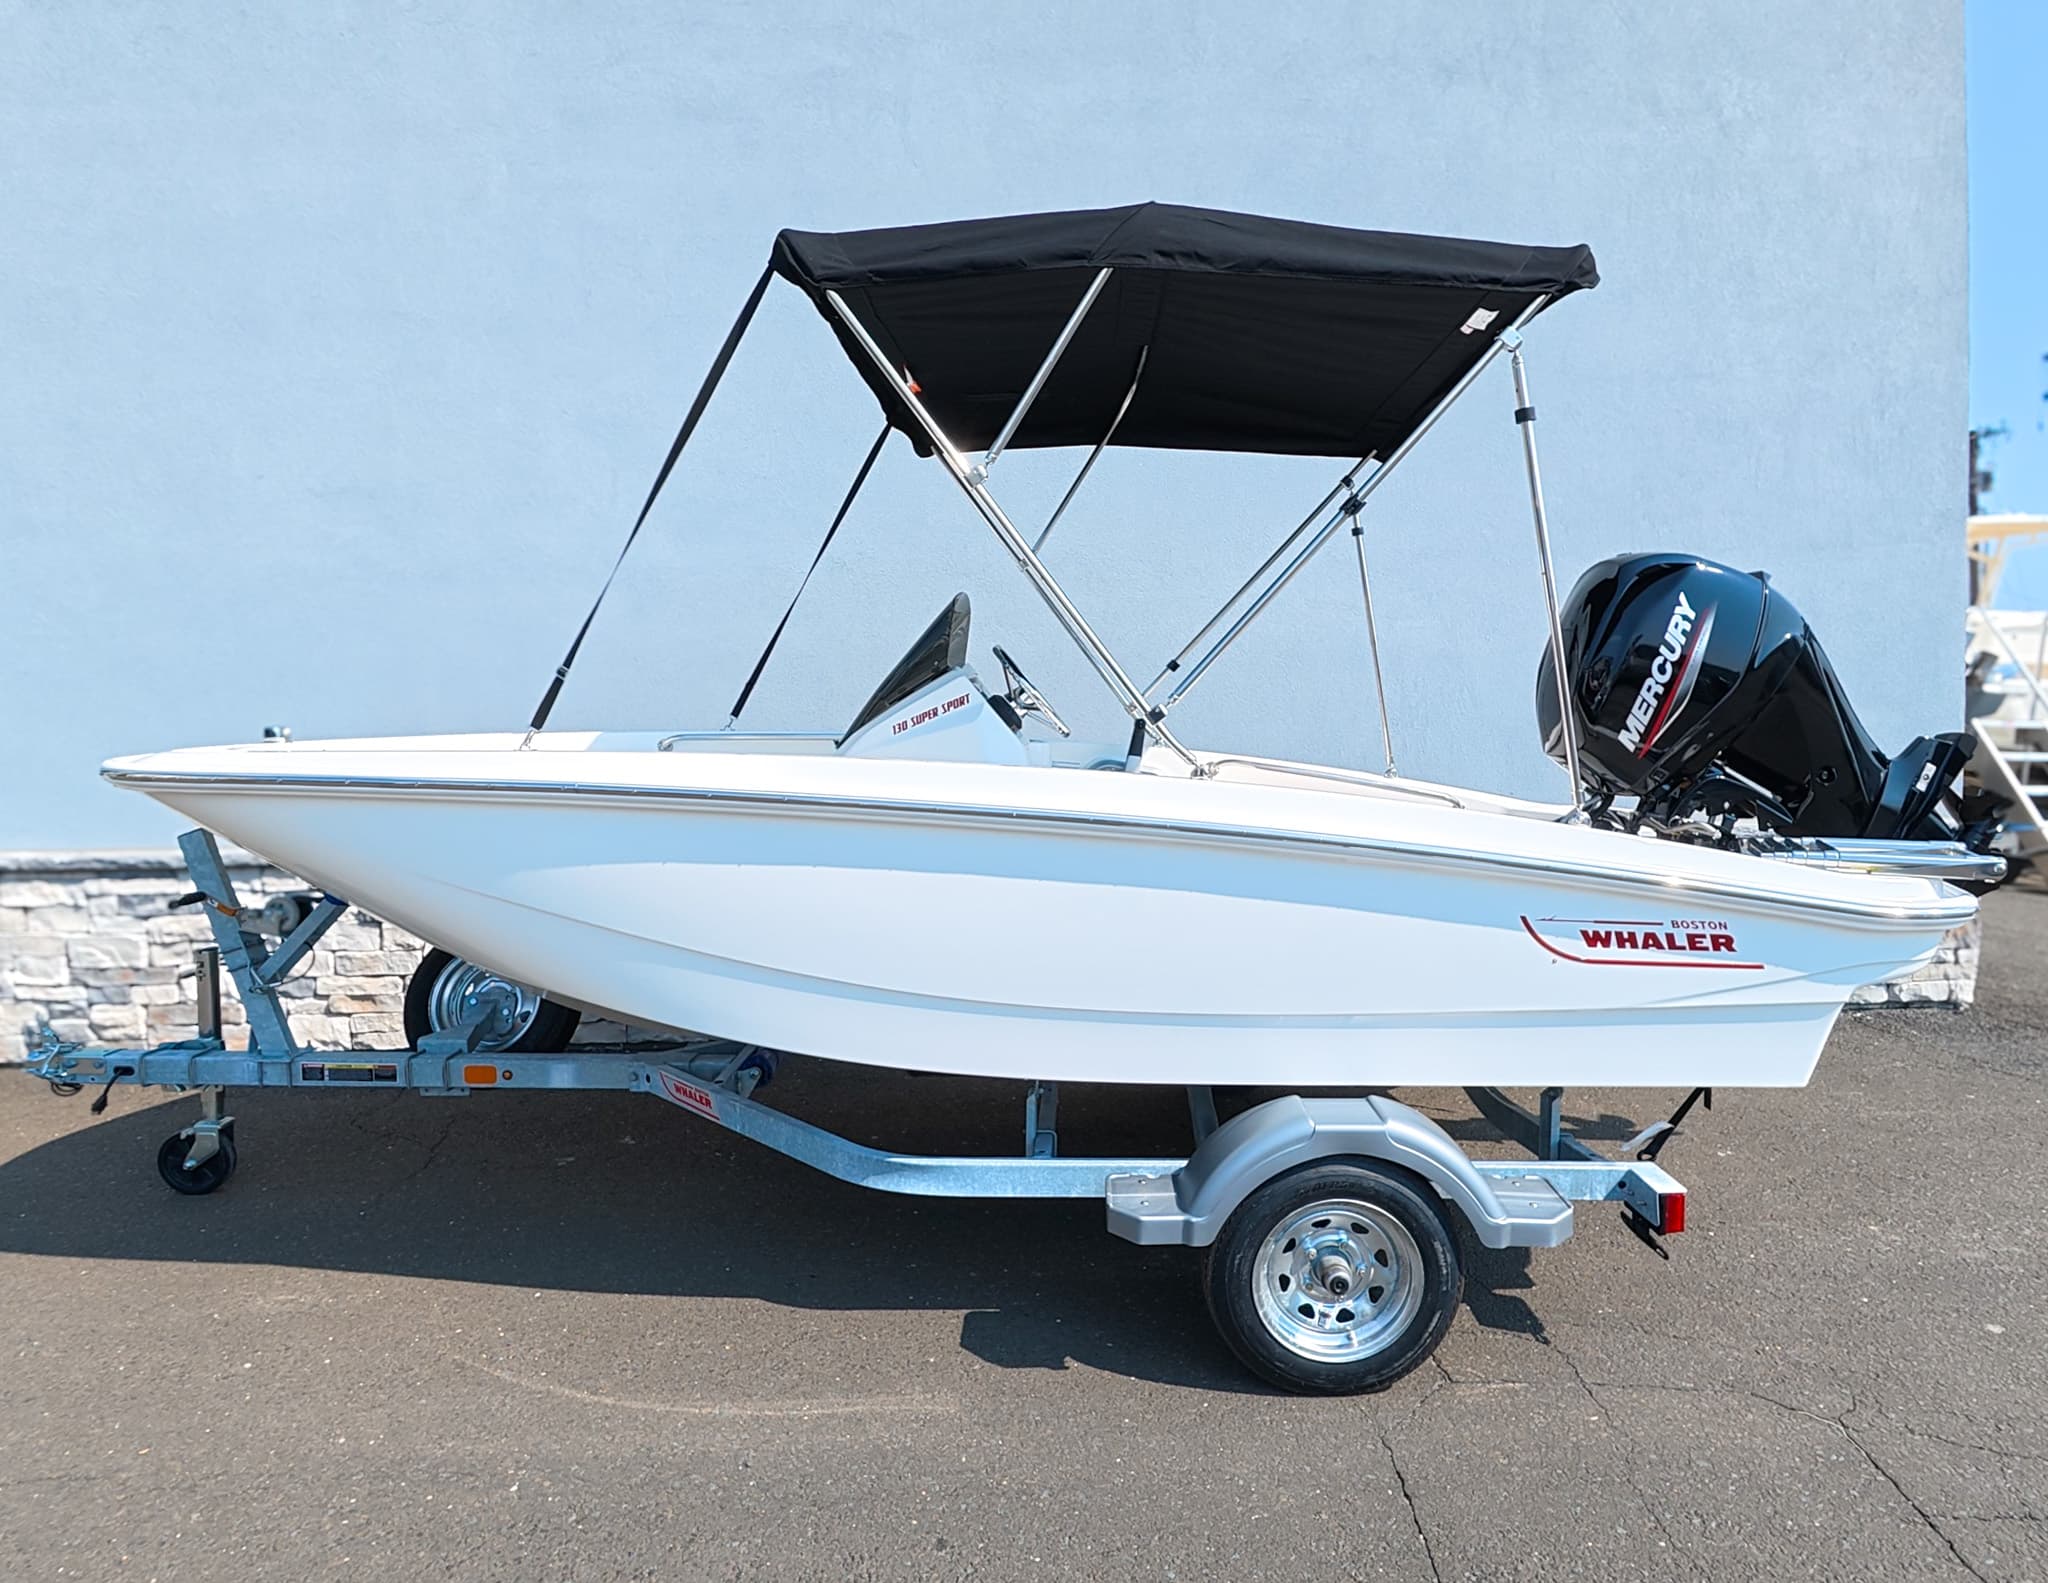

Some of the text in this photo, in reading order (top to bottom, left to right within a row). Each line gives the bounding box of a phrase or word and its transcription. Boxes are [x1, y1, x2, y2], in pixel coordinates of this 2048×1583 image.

[1617, 591, 1696, 752] MERCURY
[892, 693, 970, 735] 130 SUPER SPORT
[1671, 919, 1728, 930] BOSTON
[1580, 929, 1738, 952] WHALER
[673, 1082, 712, 1109] WHALER
